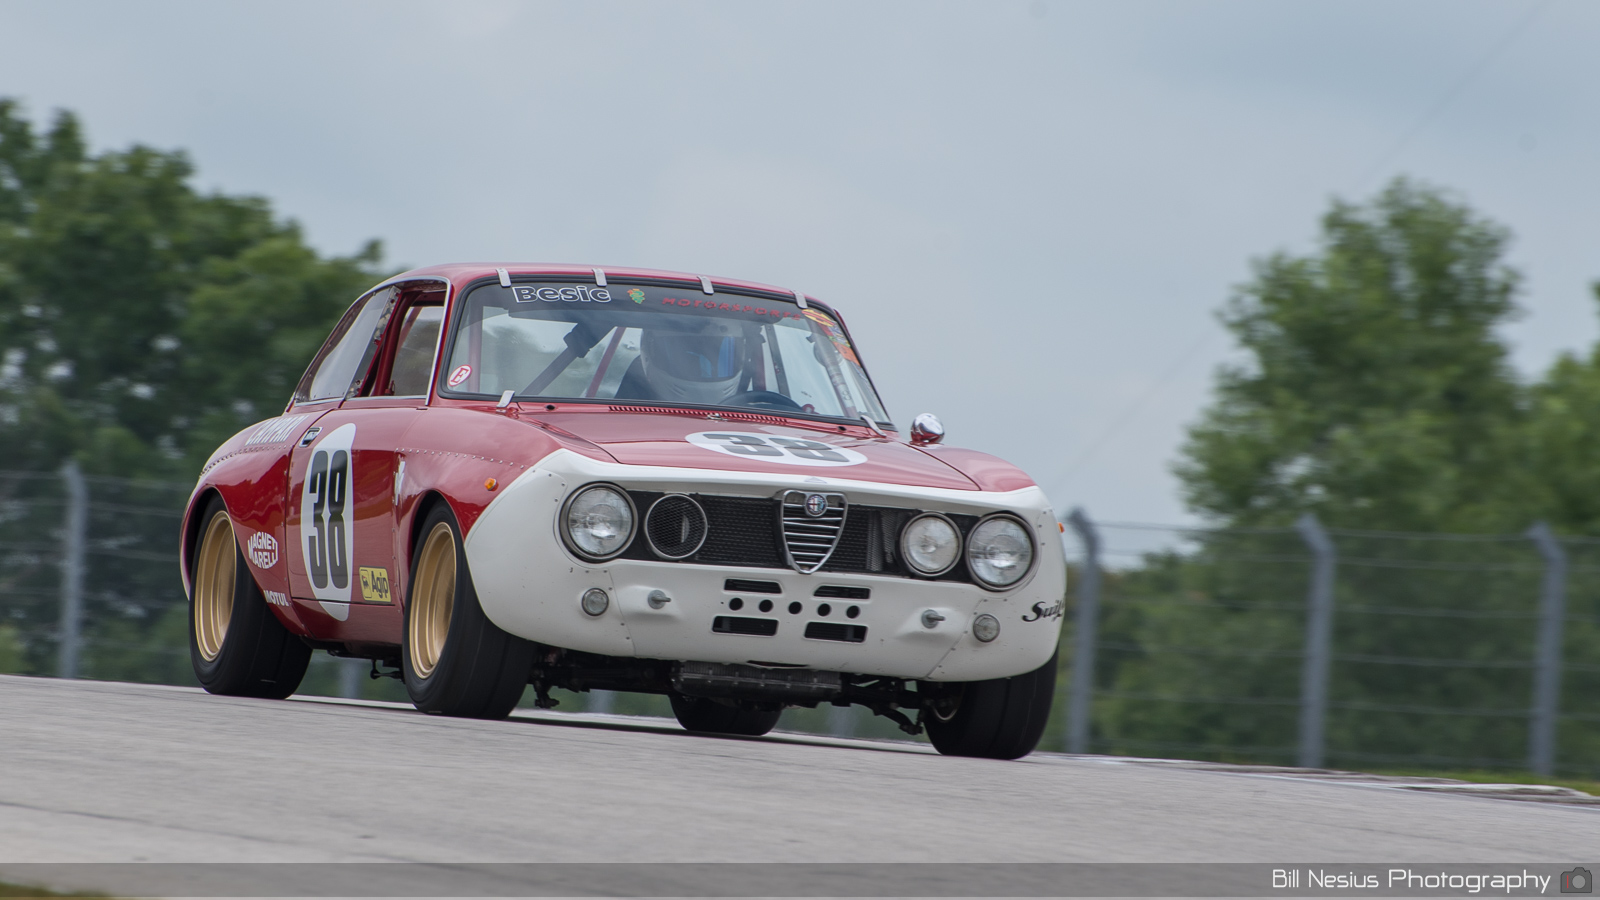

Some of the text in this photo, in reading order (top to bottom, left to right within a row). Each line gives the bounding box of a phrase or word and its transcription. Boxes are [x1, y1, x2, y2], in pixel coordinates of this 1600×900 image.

[512, 285, 612, 303] Besic
[661, 297, 802, 321] MOTORSPORTS
[450, 367, 470, 384] E
[703, 433, 851, 463] 38
[308, 449, 349, 589] 38
[371, 570, 389, 599] Agip
[263, 589, 290, 607] MOTUL
